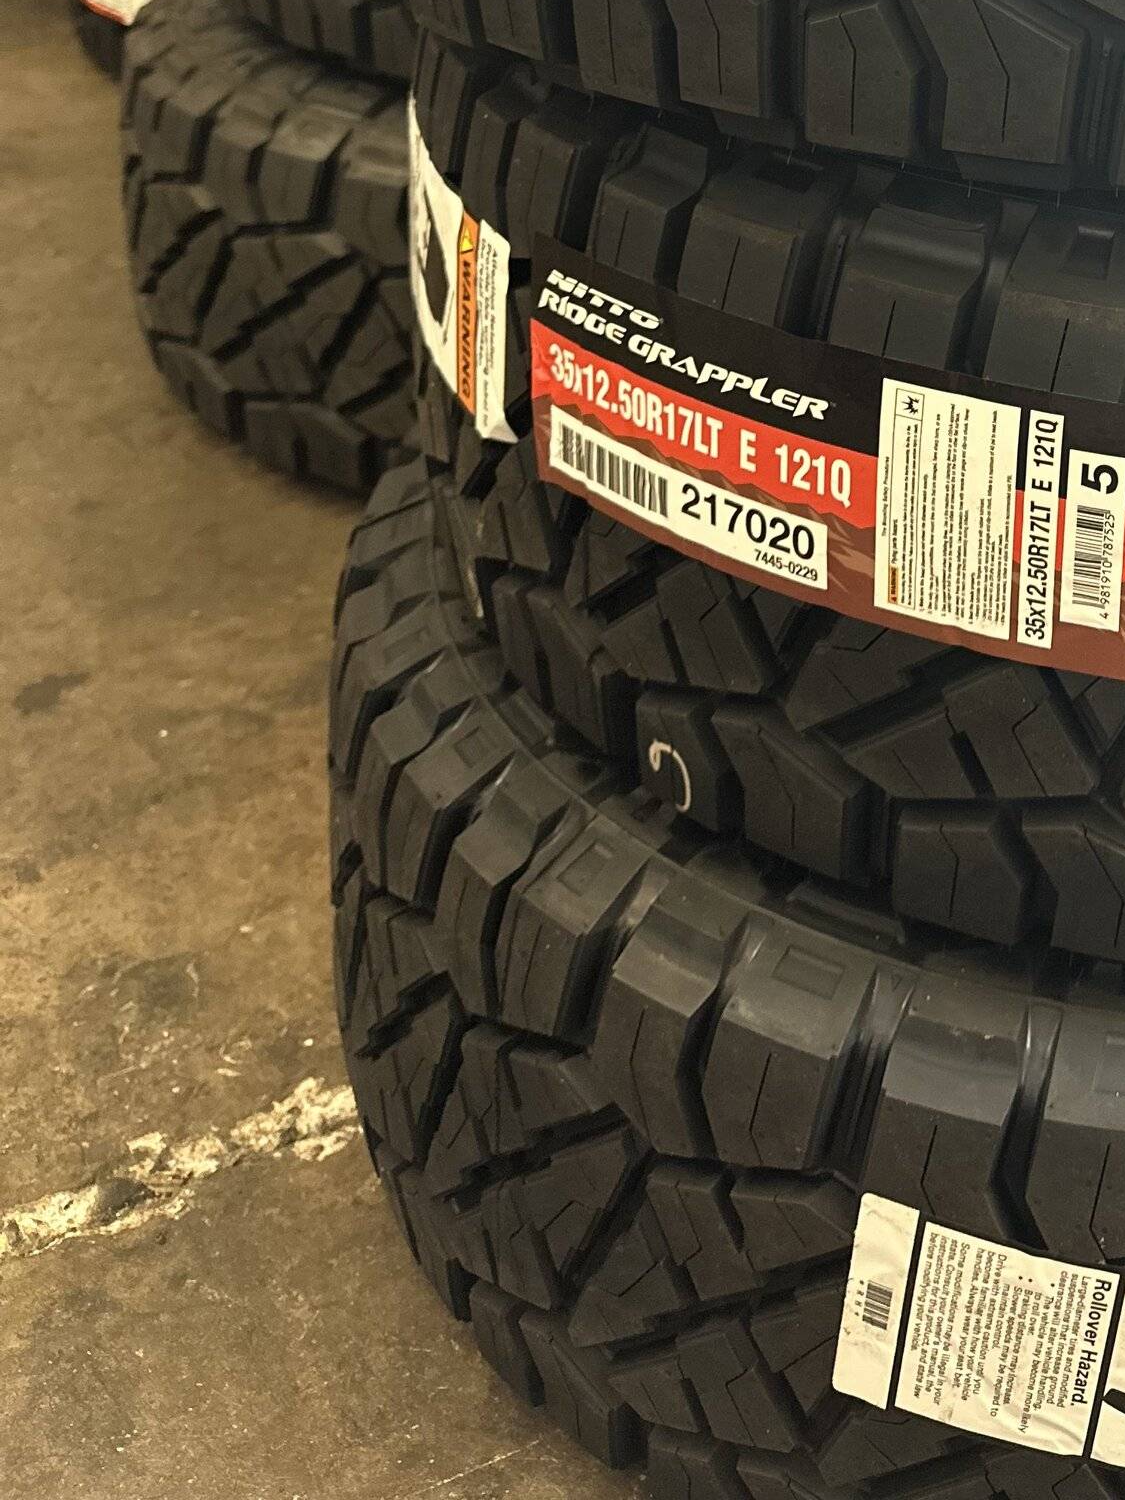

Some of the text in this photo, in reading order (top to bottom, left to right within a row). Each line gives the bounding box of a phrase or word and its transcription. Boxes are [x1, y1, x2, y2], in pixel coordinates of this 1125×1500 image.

[461, 260, 471, 399] WARNING
[538, 288, 830, 420] RIDGE GRAPPLER
[546, 269, 660, 330] NITTO
[549, 343, 852, 509] 35x12.50R17LT E 121Q
[1080, 462, 1119, 495] 5
[681, 483, 815, 561] 217020
[754, 549, 818, 582] 7445-0229
[1025, 418, 1059, 640] 35x12.50R17LT E 121Q
[1070, 1278, 1111, 1409] Rollover Hazard.
